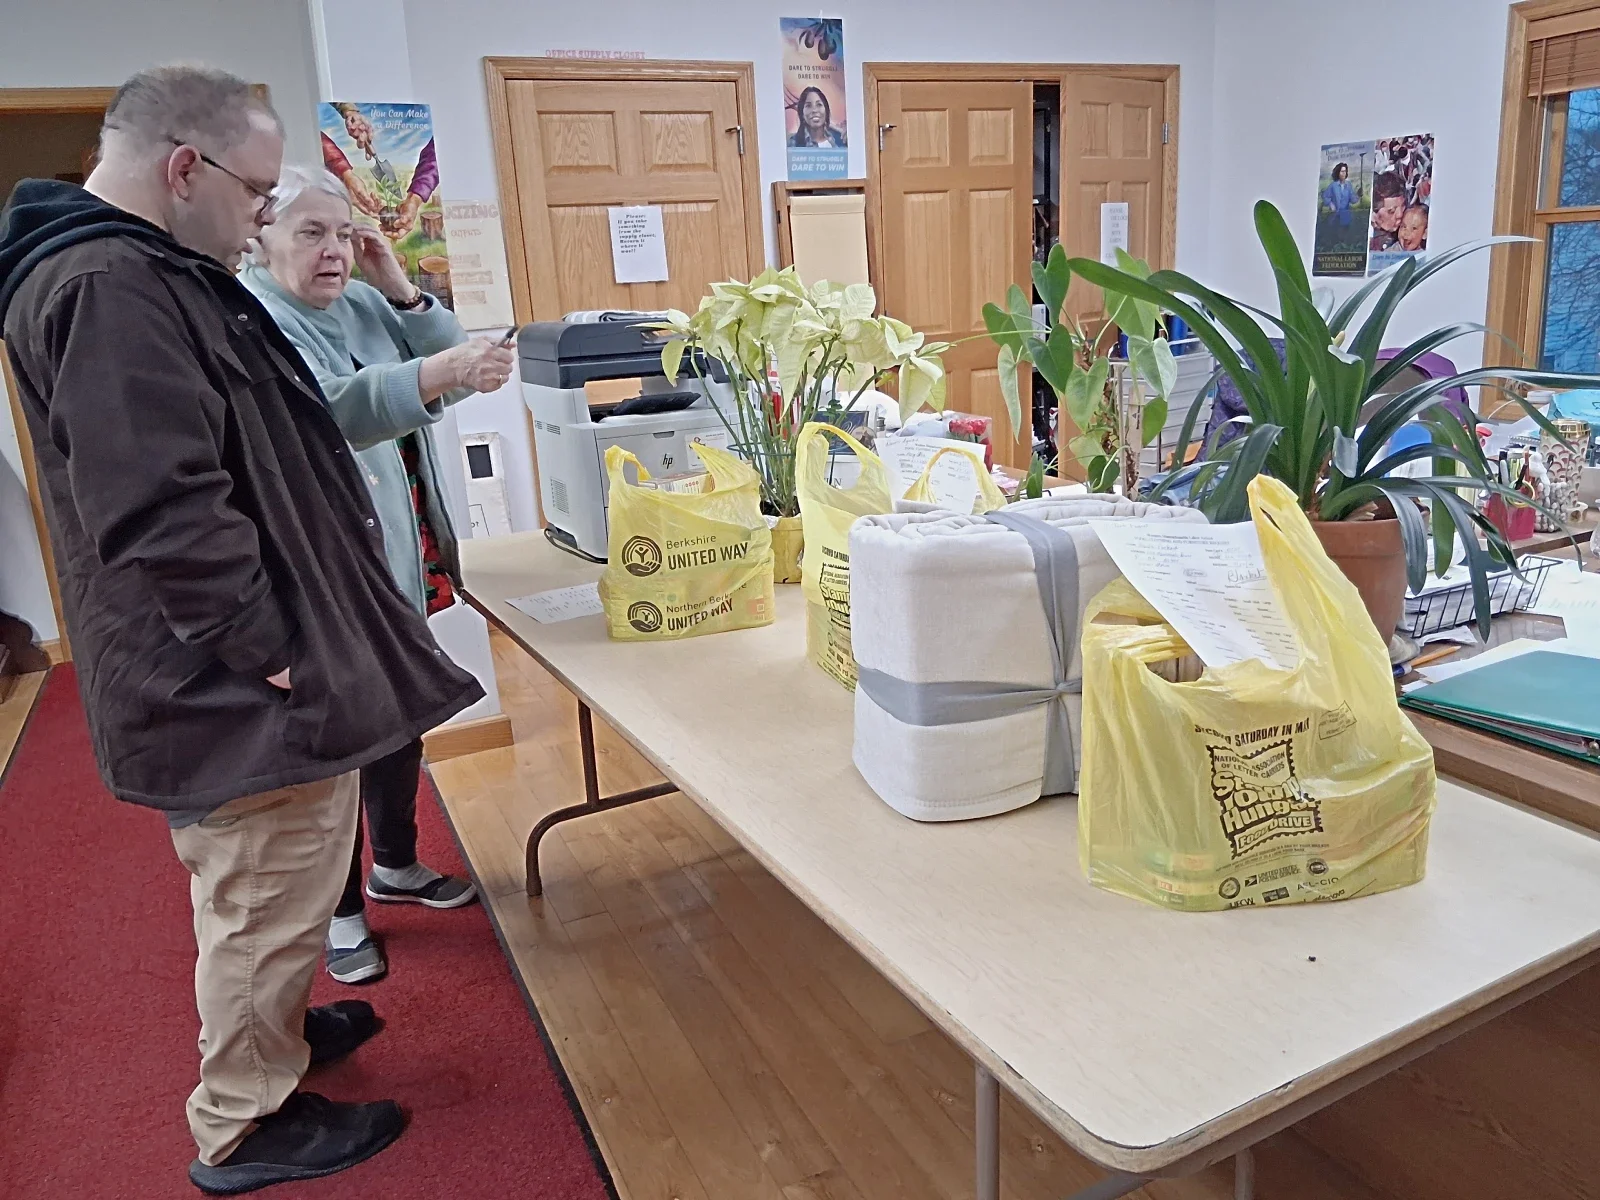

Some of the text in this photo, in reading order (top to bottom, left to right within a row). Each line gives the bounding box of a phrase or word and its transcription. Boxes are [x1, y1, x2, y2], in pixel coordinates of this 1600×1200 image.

[545, 49, 645, 60] OFFICE SUPPLY CLOSET
[370, 106, 429, 119] You Can Make
[385, 120, 429, 131] Difference
[791, 163, 845, 171] DARE TO WIN
[662, 453, 674, 470] hp
[666, 536, 717, 550] Berkshire
[667, 541, 749, 571] UNITED WAY
[819, 582, 850, 604] Stam
[666, 600, 707, 613] Northern
[667, 597, 733, 631] UNITED WAY
[1194, 724, 1231, 745] SCOD
[1234, 725, 1280, 747] SATURDAY
[1281, 723, 1293, 736] IN
[1233, 764, 1259, 778] LETTER
[1268, 815, 1312, 832] DRIVE
